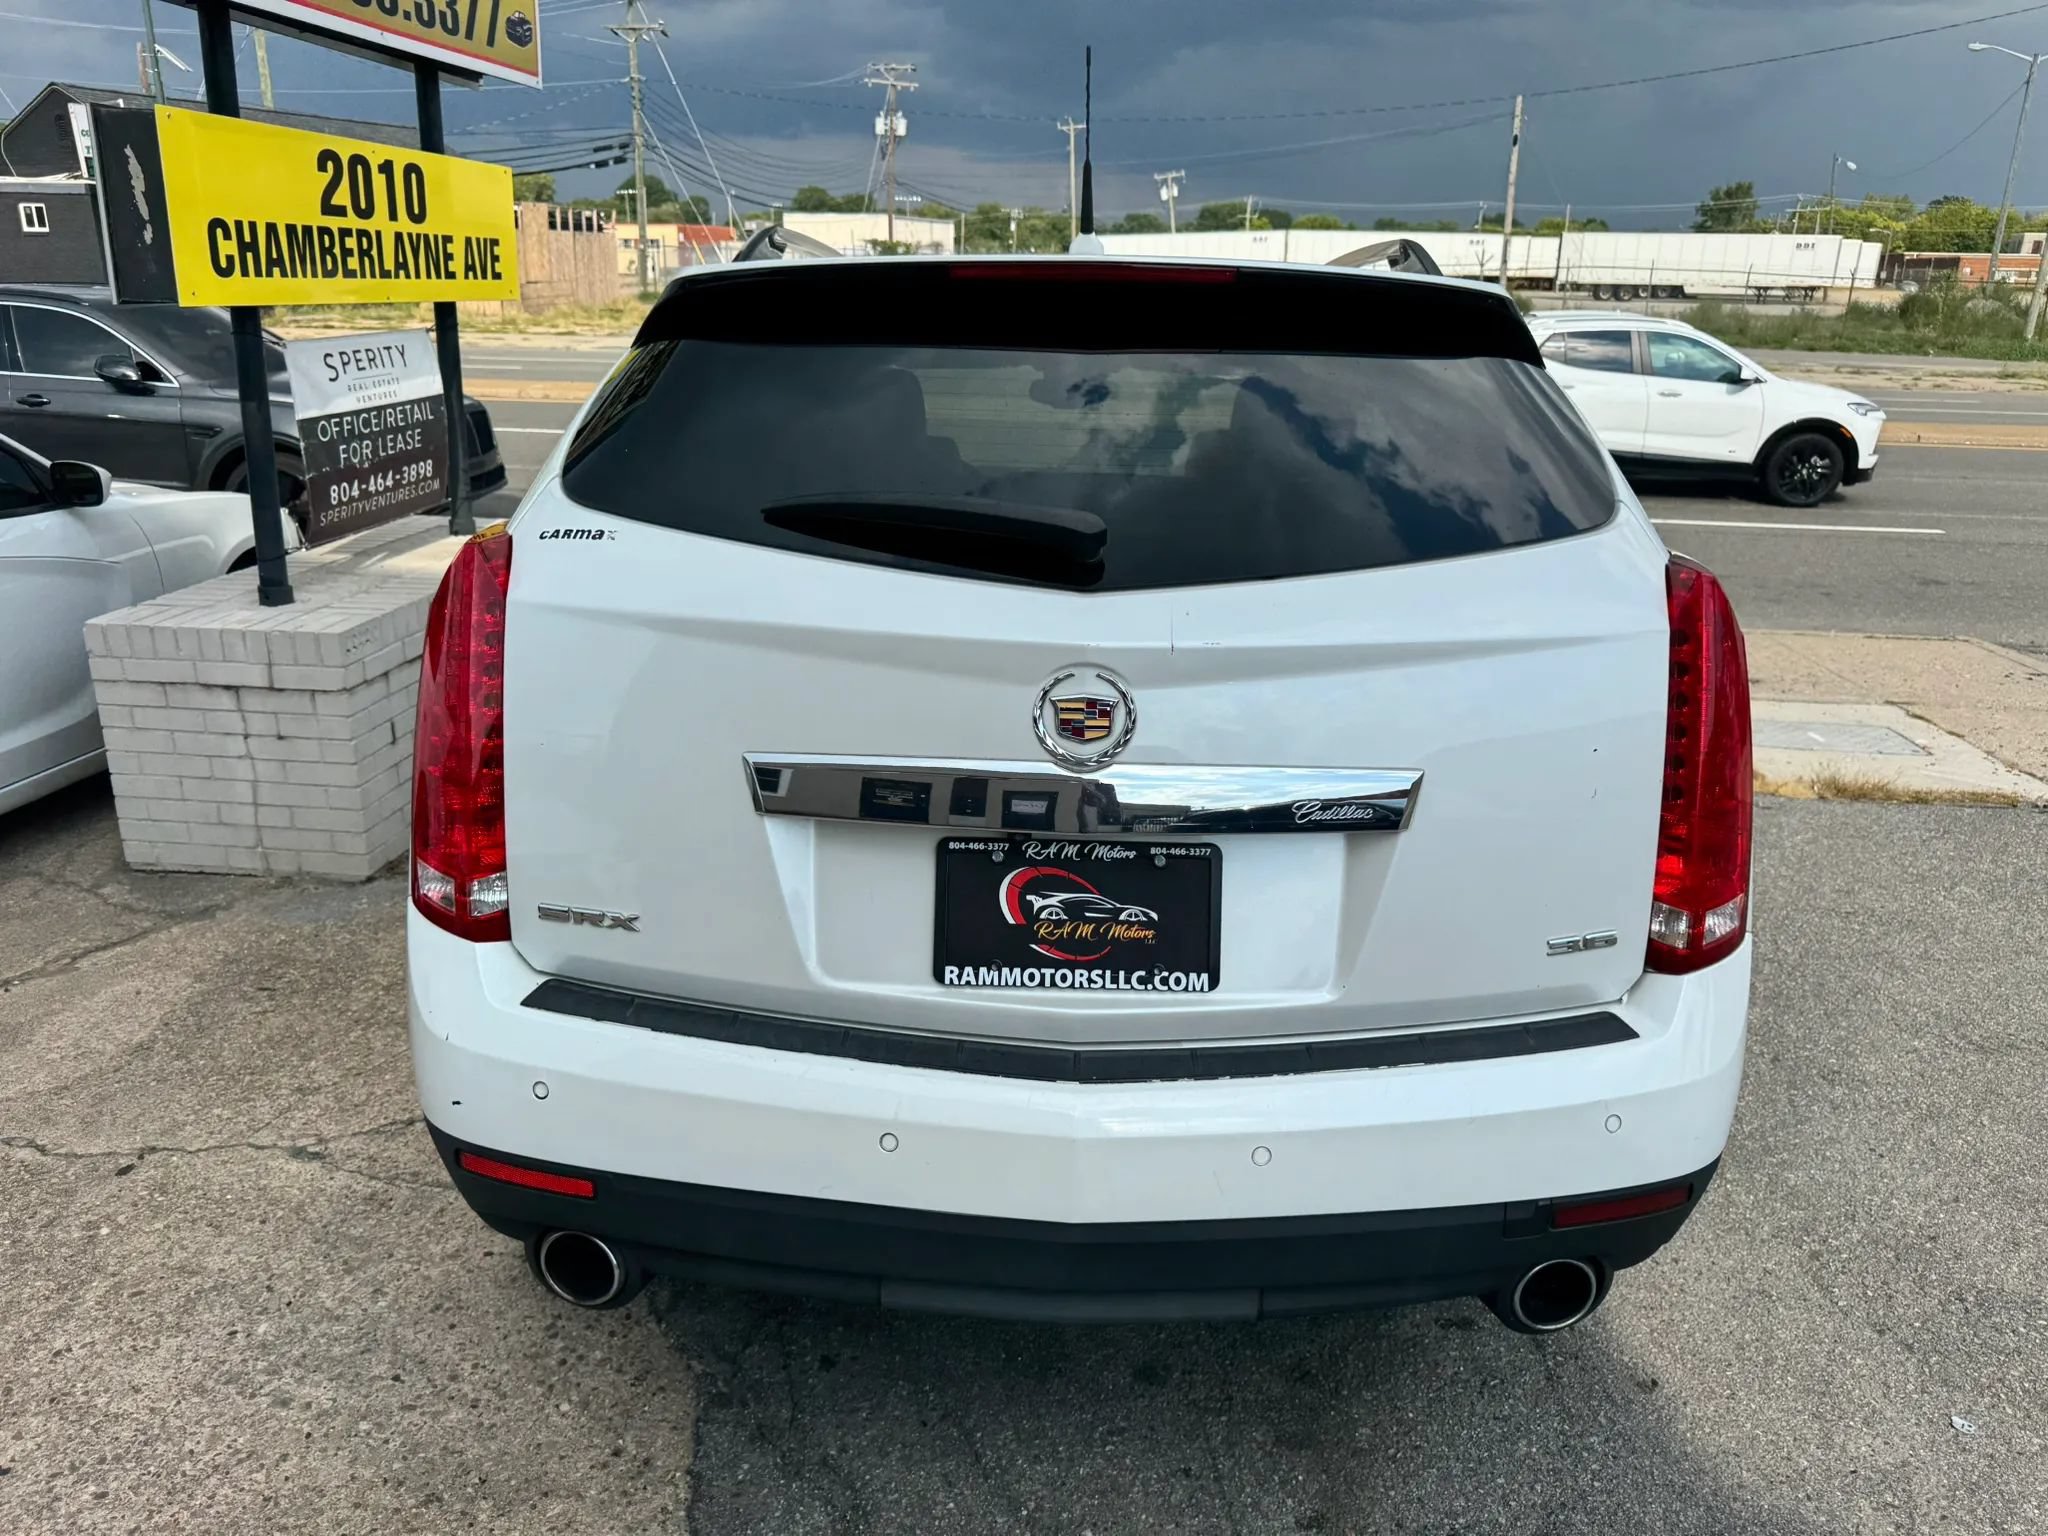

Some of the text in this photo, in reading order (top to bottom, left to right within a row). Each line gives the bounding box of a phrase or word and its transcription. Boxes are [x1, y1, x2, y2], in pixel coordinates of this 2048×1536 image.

[316, 148, 427, 225] 2010
[207, 217, 502, 281] CHAMBERLAYNE AVE
[323, 344, 408, 382] SPERITY
[317, 401, 434, 442] OFFICE/RETAIL
[339, 428, 422, 469] FOR LEASE
[320, 478, 440, 527] SPERITYVENTURES.COM
[330, 459, 433, 505] 804-464-3898
[1291, 801, 1373, 823] Cadillac
[949, 841, 1211, 861] 804-466-3377 RAM Motors 804-466-3377
[1034, 921, 1157, 941] RAM Motors
[944, 965, 1210, 992] RAMMOTORSLLC.COM
